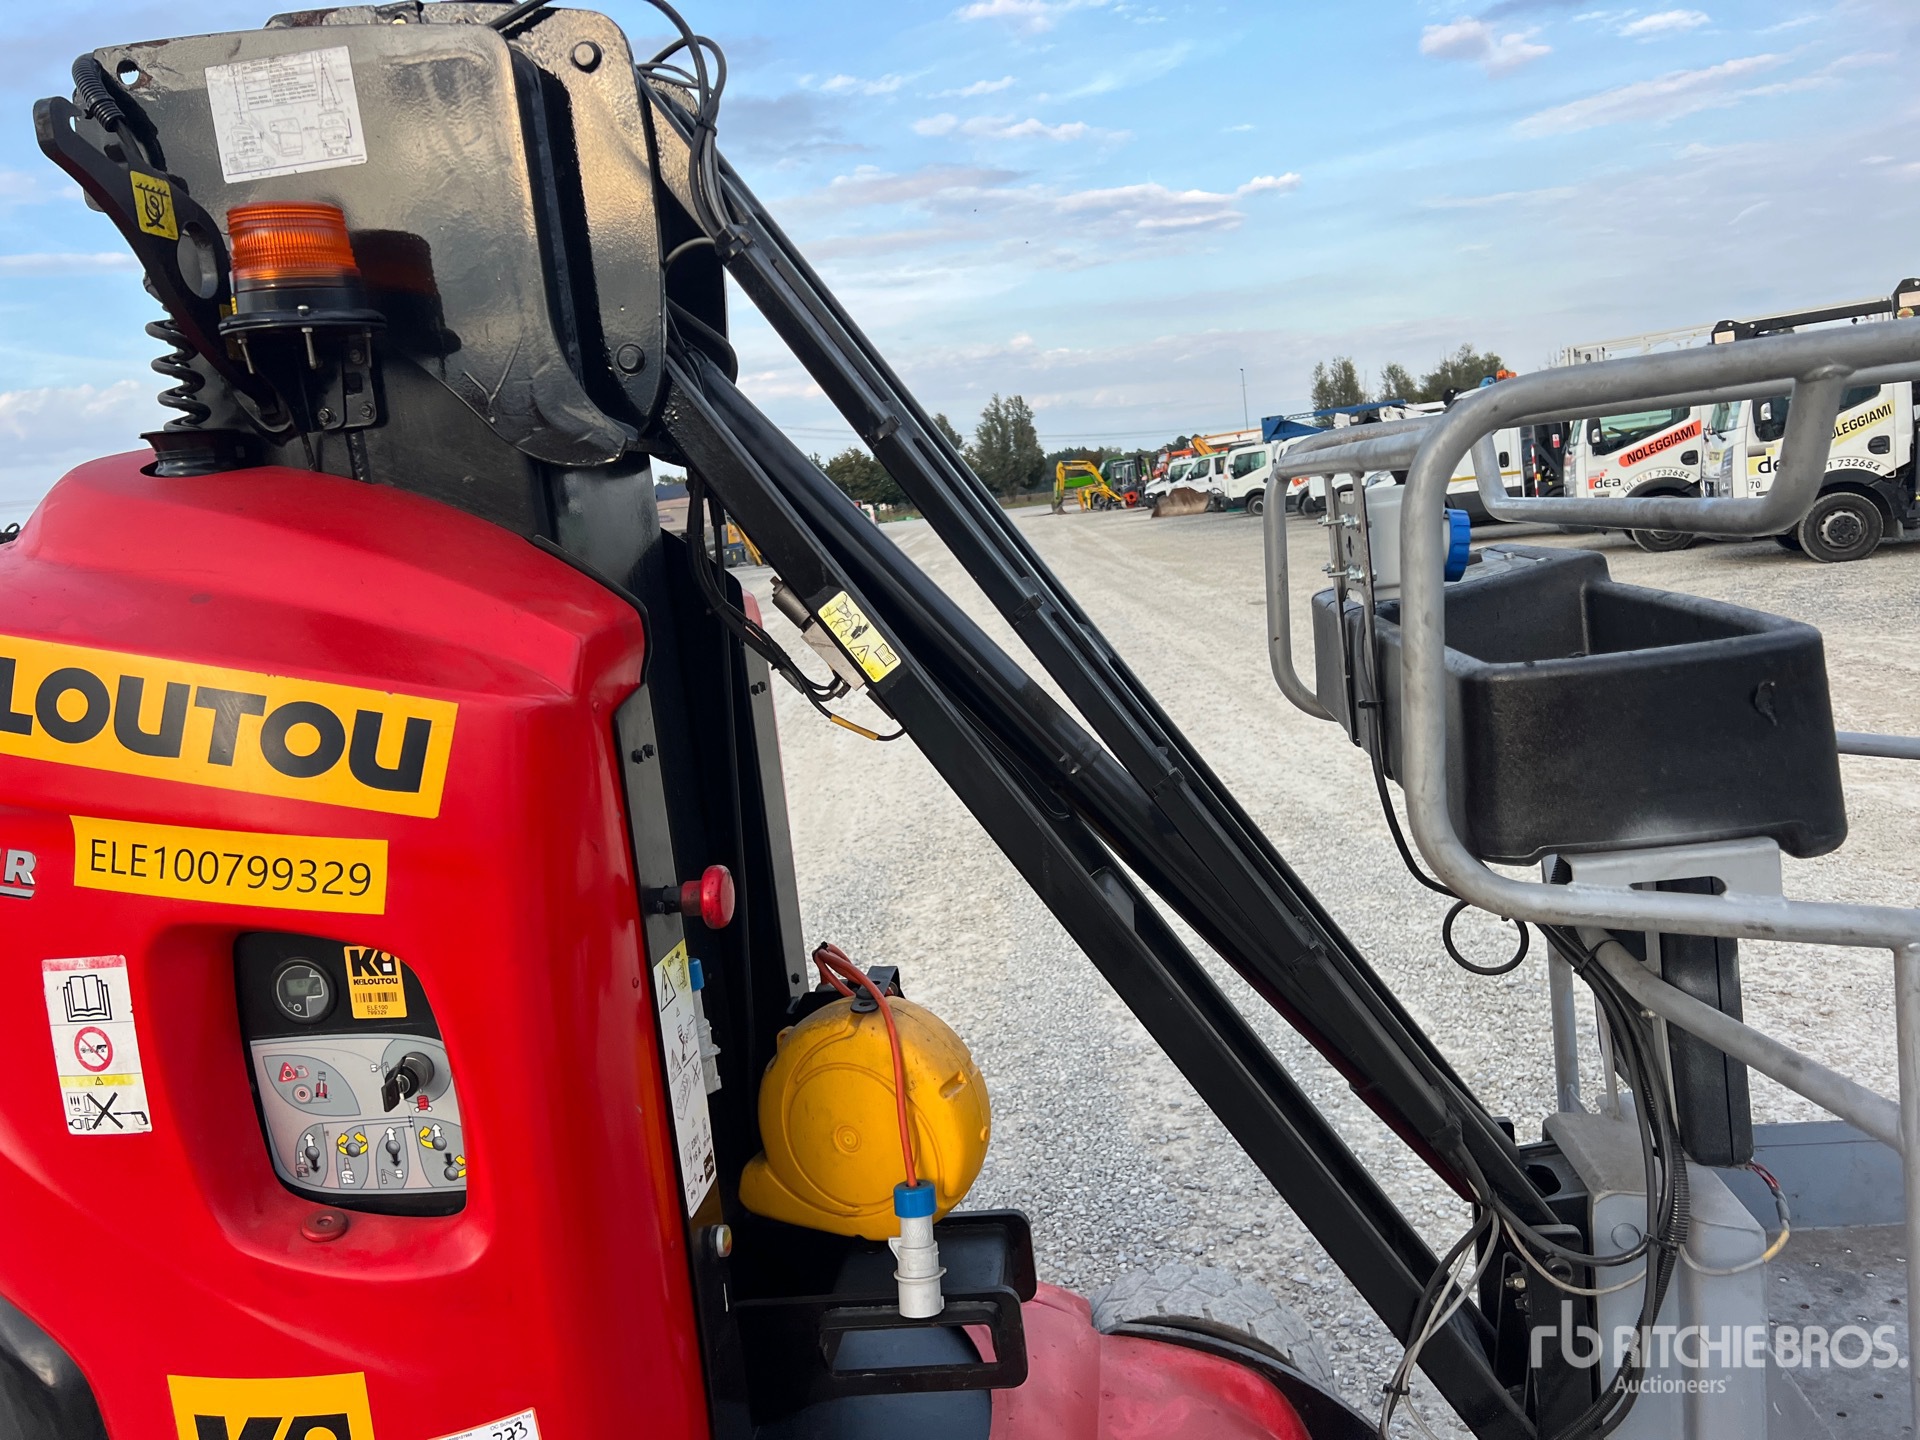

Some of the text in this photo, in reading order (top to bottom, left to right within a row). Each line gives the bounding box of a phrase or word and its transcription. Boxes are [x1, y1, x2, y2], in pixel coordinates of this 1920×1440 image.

[1627, 425, 1695, 464] NOLEGGIAMI
[1837, 458, 1881, 471] 732684
[1656, 469, 1690, 479] 732684
[1594, 477, 1621, 488] dea
[1749, 480, 1761, 489] 70
[91, 838, 372, 897] ELE100799329
